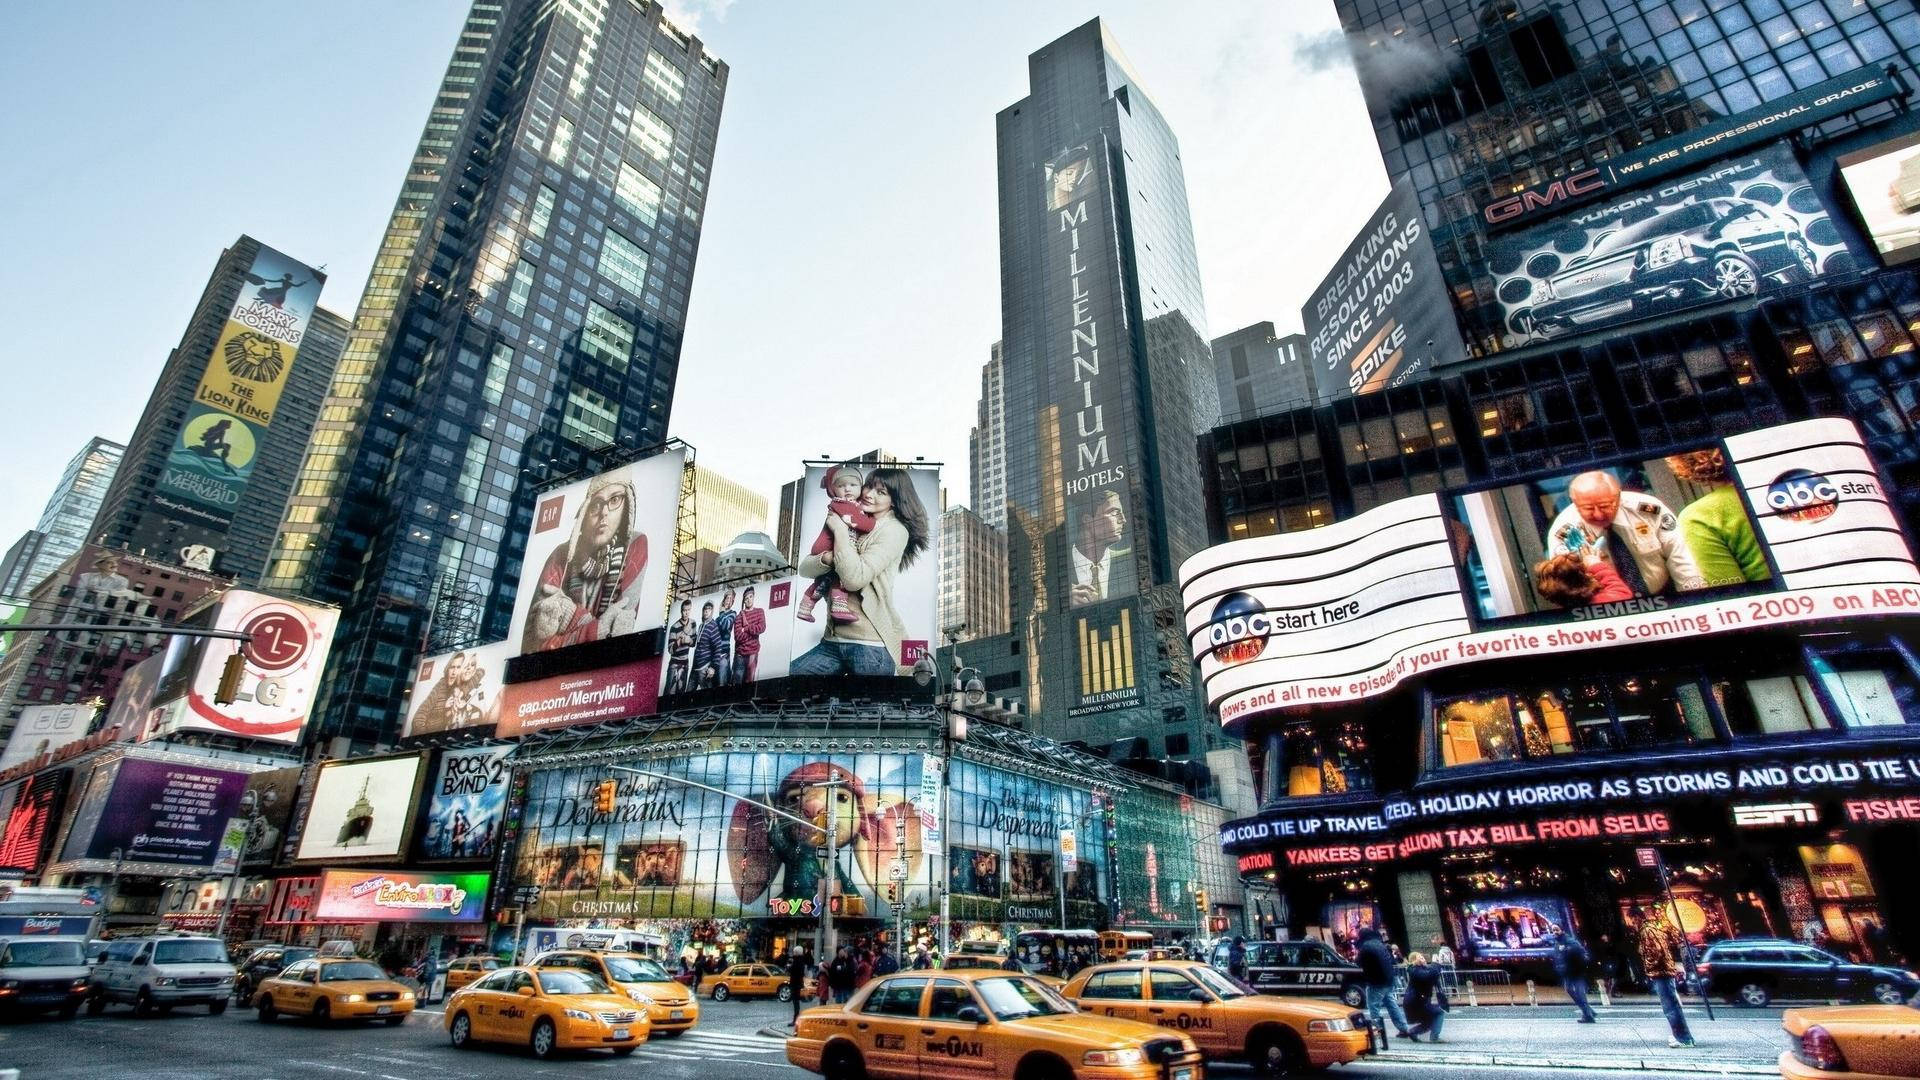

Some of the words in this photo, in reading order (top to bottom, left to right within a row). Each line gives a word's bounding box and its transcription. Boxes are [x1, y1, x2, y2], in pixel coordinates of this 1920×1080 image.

[1484, 167, 1605, 224] GMC
[1620, 161, 1644, 175] WE
[1648, 149, 1680, 166] ARE
[1683, 104, 1811, 154] PROFESSIONAL
[1572, 193, 1654, 225] YUKON
[1660, 158, 1762, 198] DENALI
[1316, 212, 1398, 322] BREAKING
[1310, 217, 1421, 359] RESOLUTIONS
[235, 306, 301, 344] POPPINS
[249, 301, 297, 328] MARY
[1326, 308, 1373, 371] SINCE
[1373, 260, 1414, 317] 2003
[1059, 200, 1110, 472] MILLENNIUM
[1349, 323, 1407, 394] SPIKE
[1391, 357, 1422, 390] ACTION
[200, 384, 234, 407] LION
[235, 398, 270, 420] KING
[231, 382, 255, 399] THE
[162, 470, 239, 505] MERMAID
[184, 471, 201, 482] THE
[202, 477, 229, 490] LITTLE
[1066, 465, 1125, 496] HOTELS
[1767, 482, 1837, 509] abc
[541, 504, 558, 524] GAP
[773, 590, 787, 602] GAP
[1572, 594, 1669, 621] SIEMENS
[1210, 609, 1271, 646] abc
[1276, 609, 1317, 629] start
[1322, 598, 1360, 624] here
[1250, 690, 1276, 707] and
[1282, 685, 1301, 702] all
[1307, 684, 1342, 698] new
[1397, 656, 1406, 675] of
[1410, 648, 1450, 673] your
[1457, 633, 1539, 658] favorite
[1547, 627, 1617, 647] shows
[1625, 613, 1712, 640] coming
[1716, 607, 1741, 626] in
[1749, 595, 1815, 621] 2009
[1833, 595, 1864, 610] on
[560, 678, 593, 691] Experience
[1082, 688, 1137, 704] MILLENNIUM
[518, 681, 635, 717] gap.com/MerryMixIt
[1069, 704, 1103, 716] BROADWAY
[1121, 698, 1140, 708] YORK
[527, 716, 550, 728] surprise
[550, 714, 562, 723] cast
[563, 713, 570, 722] of
[570, 709, 595, 720] carolers
[595, 707, 607, 716] and
[607, 705, 625, 715] more
[447, 754, 495, 781] ROCK
[488, 760, 505, 785] 2
[163, 788, 184, 796] PLANET
[184, 789, 217, 800] HOLLYWOOD
[442, 774, 488, 796] BAND
[615, 777, 644, 798] Tale
[1420, 792, 1501, 816] HOLIDAY
[1507, 782, 1595, 806] HORROR
[1601, 779, 1632, 798] AS
[1636, 771, 1732, 795] STORMS
[1738, 767, 1789, 788] AND
[1793, 762, 1860, 785] COLD
[1863, 760, 1907, 779] TIE
[162, 804, 178, 812] NEED
[178, 805, 187, 813] TO
[186, 806, 198, 814] GET
[177, 797, 195, 806] GREAT
[1000, 786, 1020, 810] The
[1021, 791, 1043, 813] Tale
[167, 813, 181, 821] NEW
[180, 814, 197, 822] YORK
[980, 799, 1059, 845] Despereau
[1733, 803, 1819, 825] ESPN
[1237, 823, 1269, 841] COLD
[1271, 821, 1295, 836] TIE
[1299, 820, 1321, 833] UP
[1324, 816, 1387, 832] TRAVEL
[1286, 847, 1362, 865] YANKEES
[1364, 844, 1396, 861] GET
[1445, 827, 1487, 847] TAX
[1490, 823, 1535, 844] BILL
[1537, 817, 1600, 840] FROM
[1603, 813, 1671, 834] SELIG
[175, 837, 211, 847] hollywood
[572, 900, 640, 916] CHRISTMAS
[1008, 905, 1053, 919] CHRISTMAS
[24, 918, 62, 930] Budget
[1298, 972, 1334, 983] NYPD
[1177, 1012, 1212, 1029] TAXI
[947, 1035, 984, 1057] TAXI
